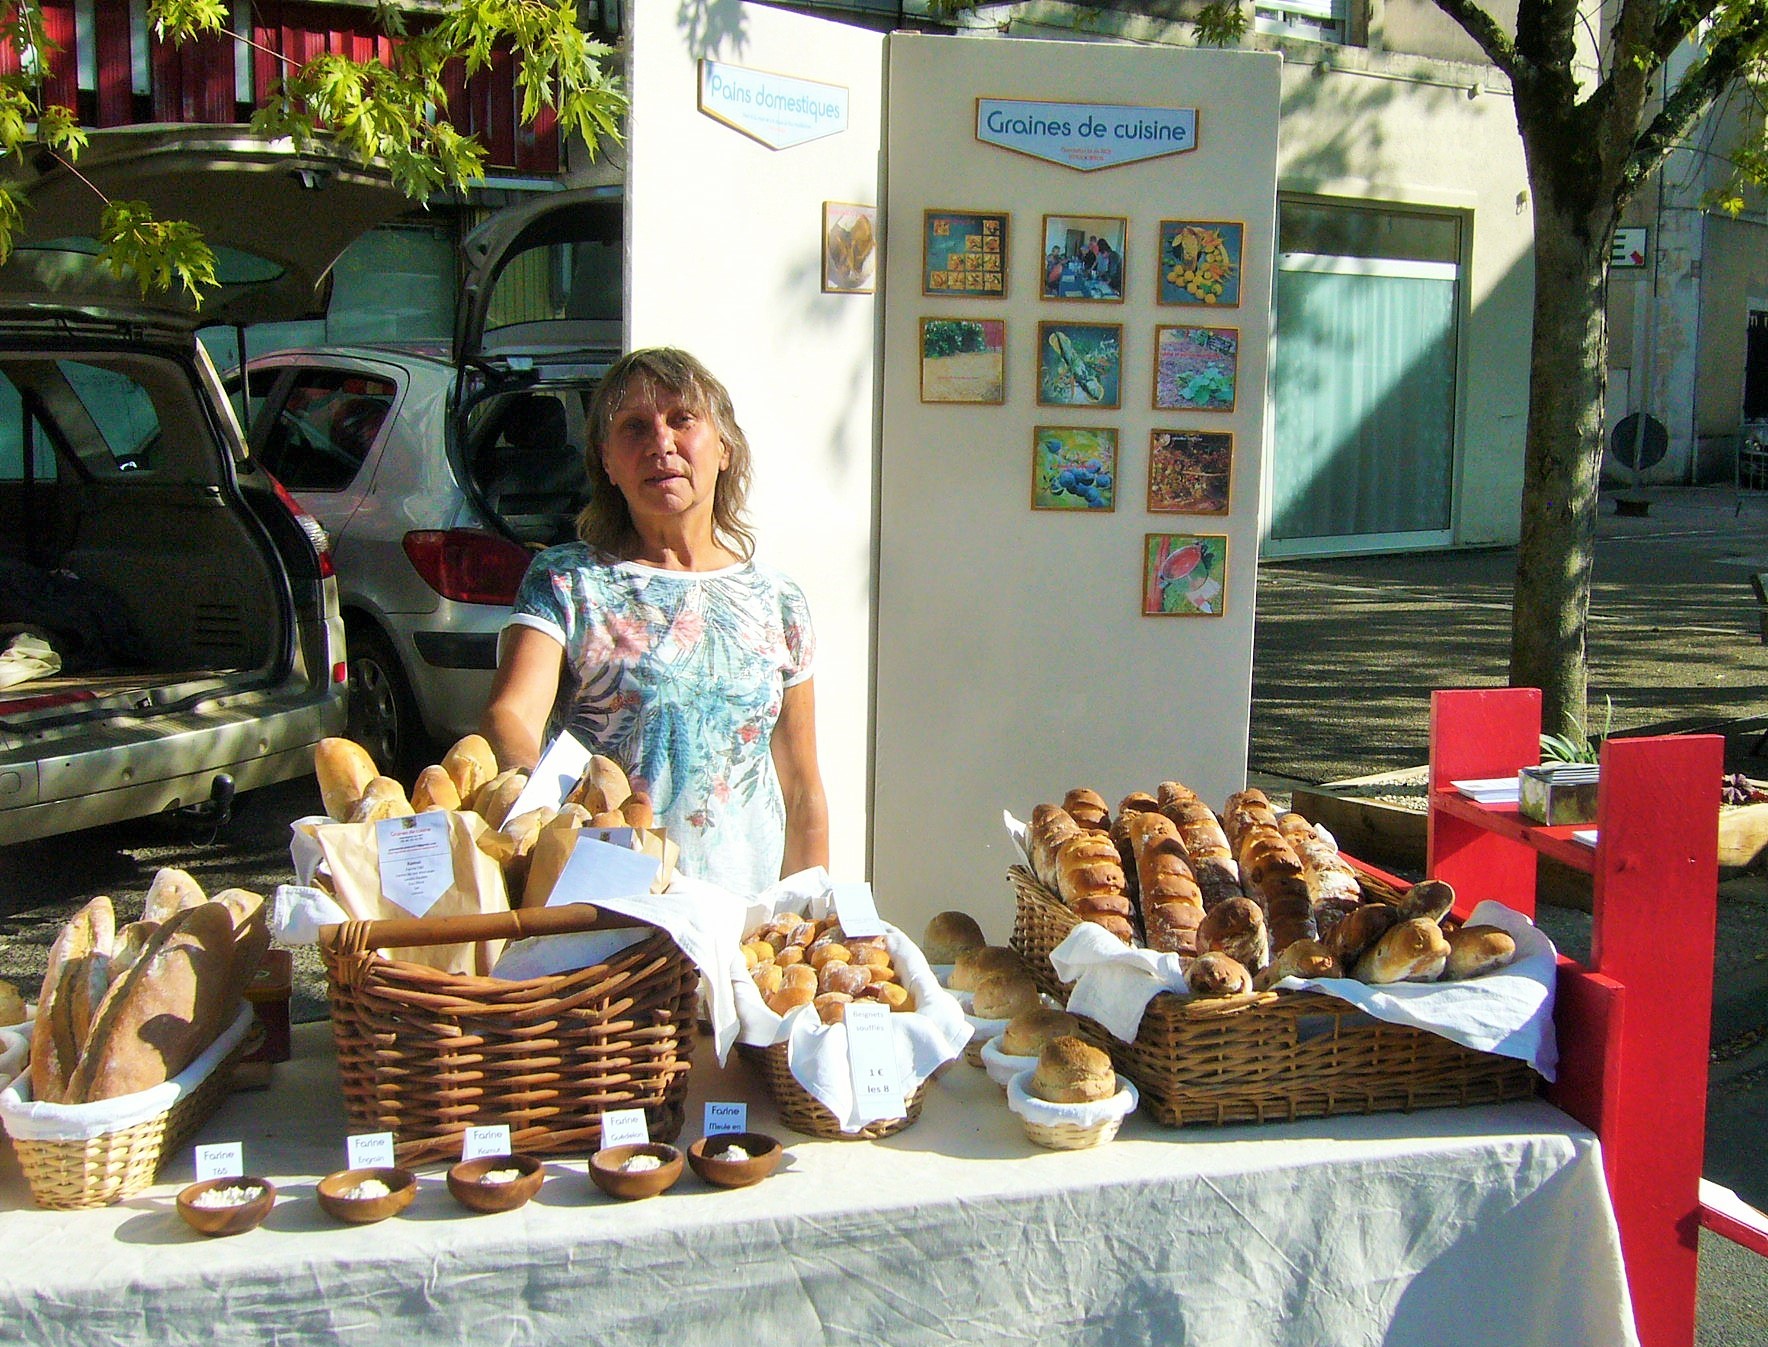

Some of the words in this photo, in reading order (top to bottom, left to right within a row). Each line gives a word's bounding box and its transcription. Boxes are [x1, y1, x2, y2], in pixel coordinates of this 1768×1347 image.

[711, 75, 751, 104] Pains
[755, 84, 840, 123] domestiques
[986, 110, 1071, 136] Graines
[1078, 115, 1107, 138] de
[1114, 120, 1186, 141] cuisine
[868, 1084, 881, 1094] les
[711, 1105, 740, 1116] Farine
[610, 1116, 639, 1126] Farine
[473, 1130, 503, 1140] Farine
[355, 1138, 385, 1149] Farine
[204, 1150, 235, 1161] Farine
